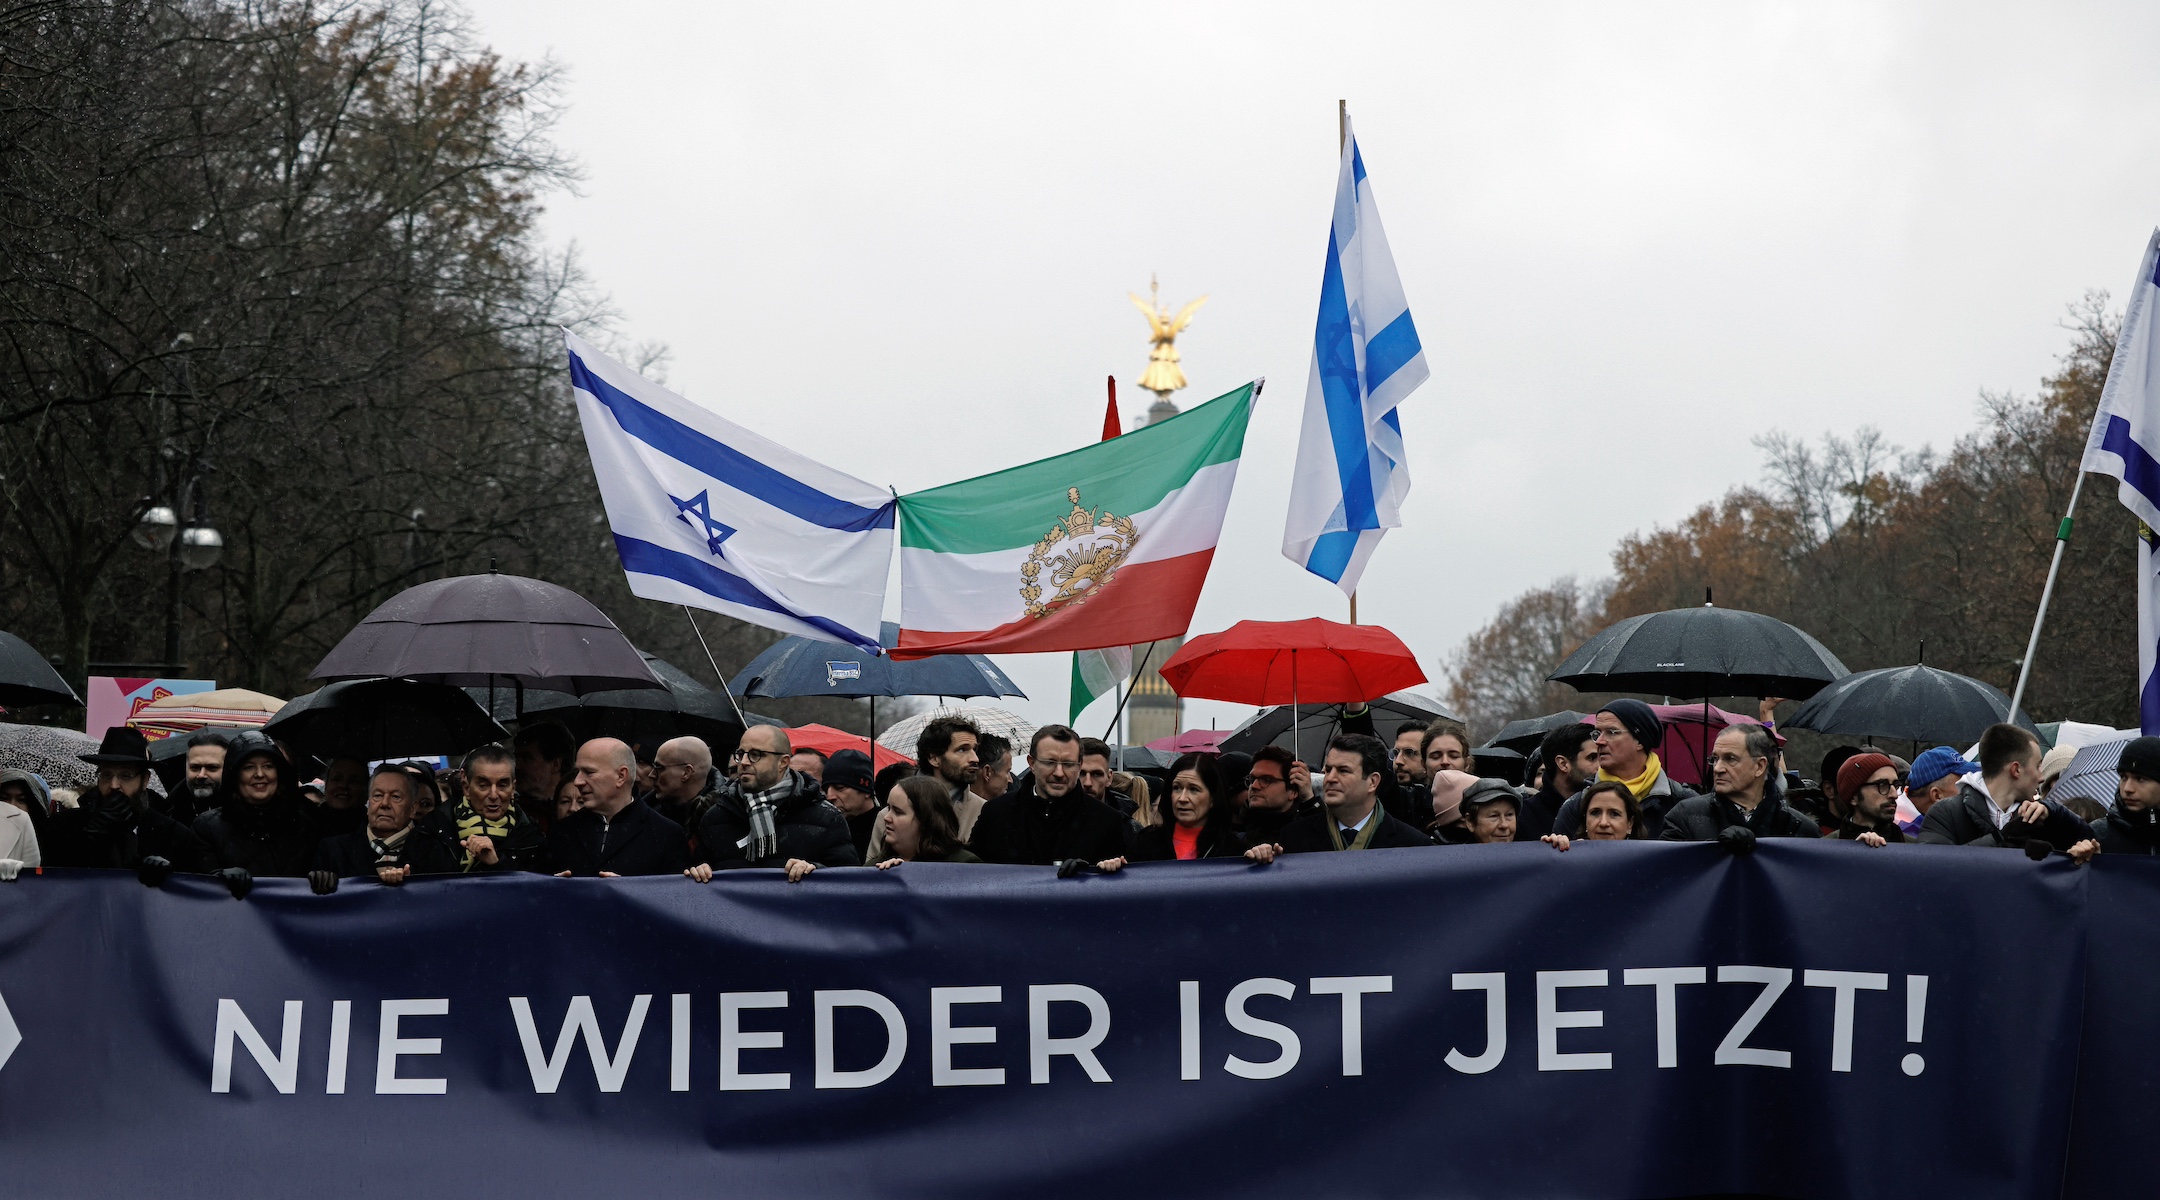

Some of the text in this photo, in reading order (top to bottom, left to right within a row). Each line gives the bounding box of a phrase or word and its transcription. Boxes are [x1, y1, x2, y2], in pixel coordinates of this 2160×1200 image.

[211, 965, 1929, 1095] NIE WIEDER IST JETZT!
